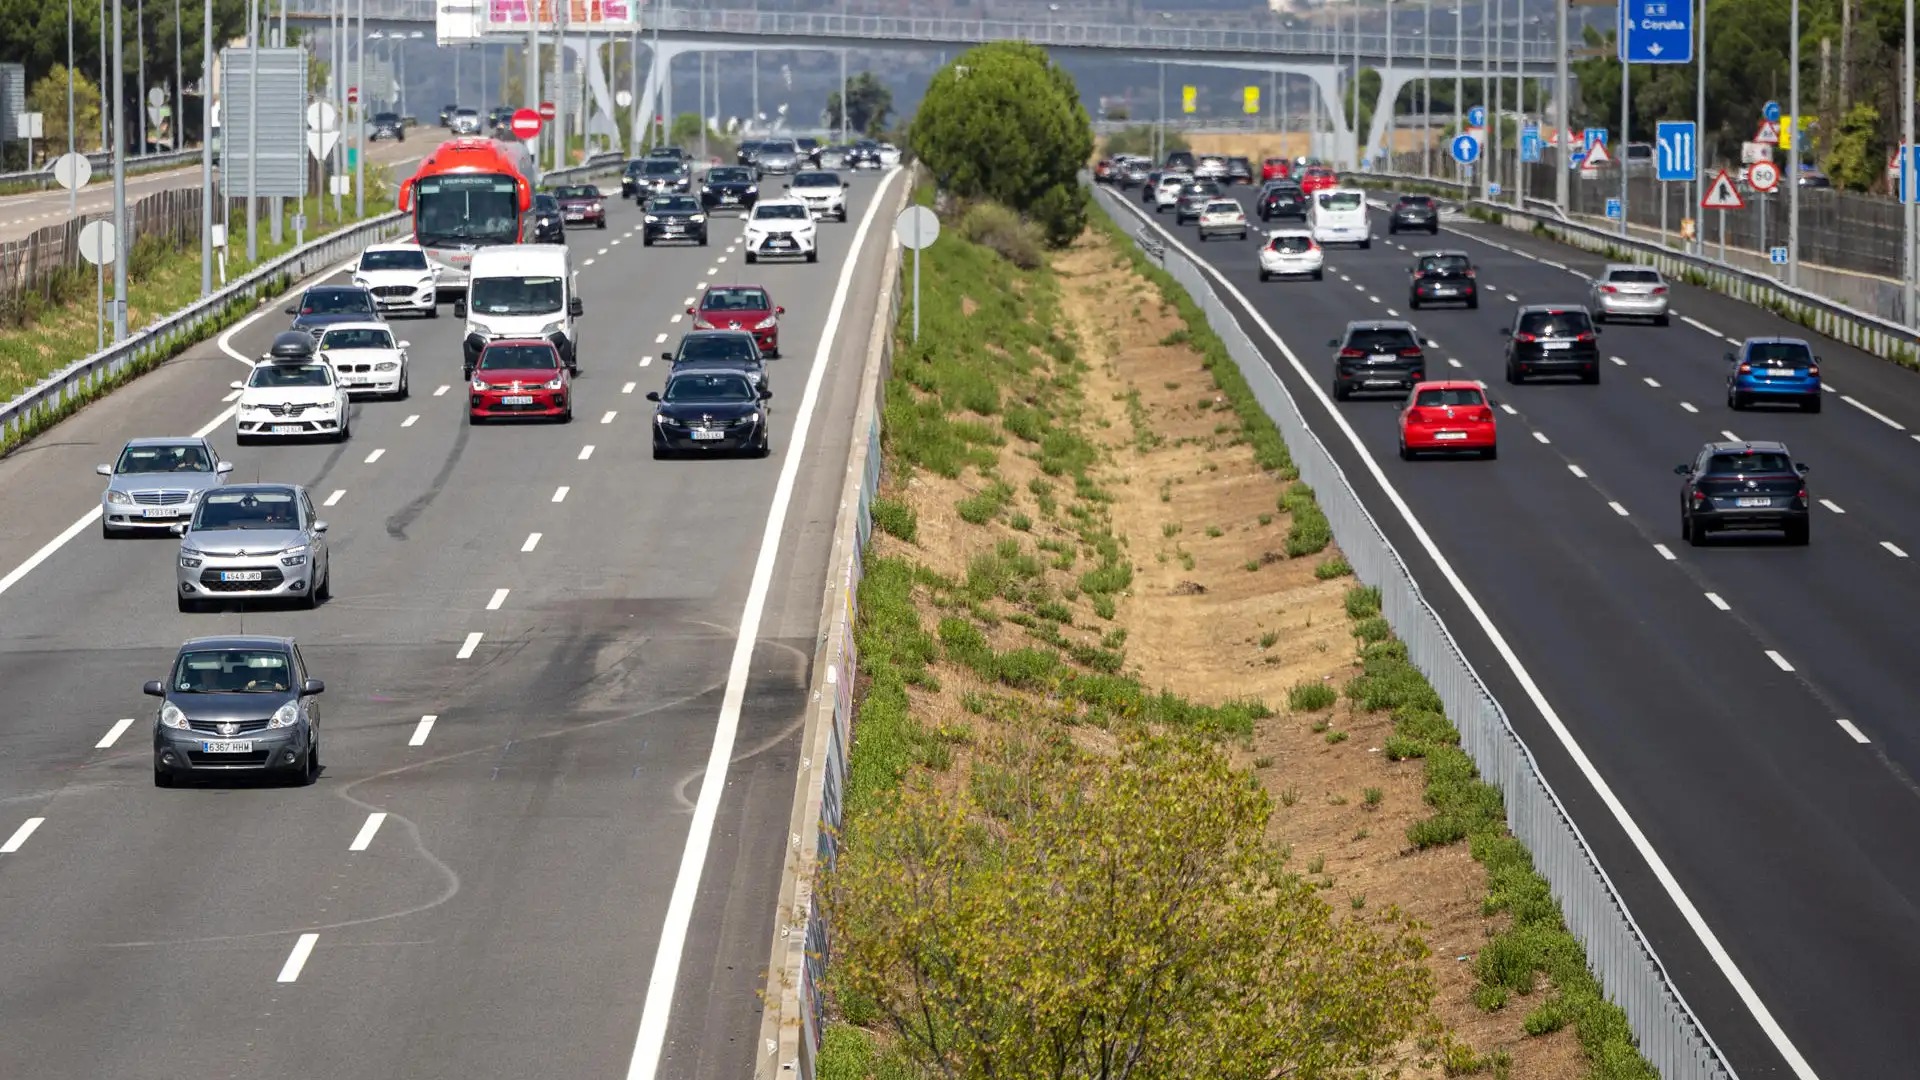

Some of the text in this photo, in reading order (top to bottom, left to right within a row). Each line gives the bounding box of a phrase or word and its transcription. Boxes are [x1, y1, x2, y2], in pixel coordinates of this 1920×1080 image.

[1755, 170, 1773, 181] 50
[226, 572, 245, 580] 4549
[209, 743, 250, 752] 6367 HHM
